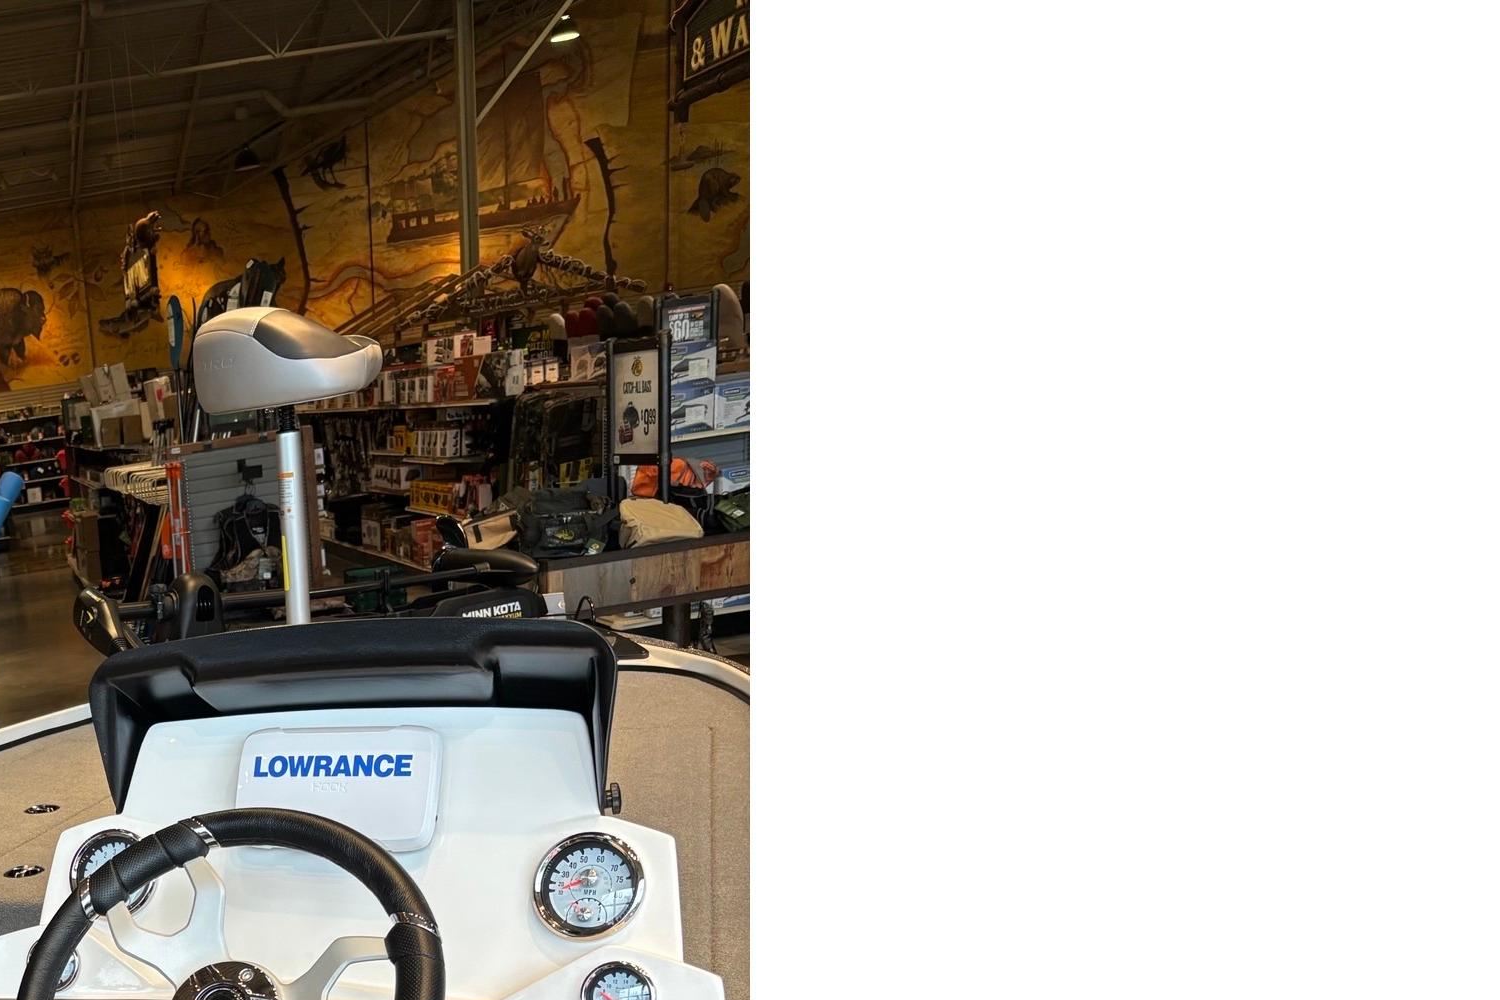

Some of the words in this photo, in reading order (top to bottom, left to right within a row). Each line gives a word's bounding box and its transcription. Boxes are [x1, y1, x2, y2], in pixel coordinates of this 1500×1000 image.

[690, 36, 706, 71] &
[493, 601, 522, 616] KOTA
[253, 754, 414, 778] LOWRANCE
[580, 855, 588, 863] 50
[596, 855, 605, 863] 60
[610, 864, 619, 872] 70
